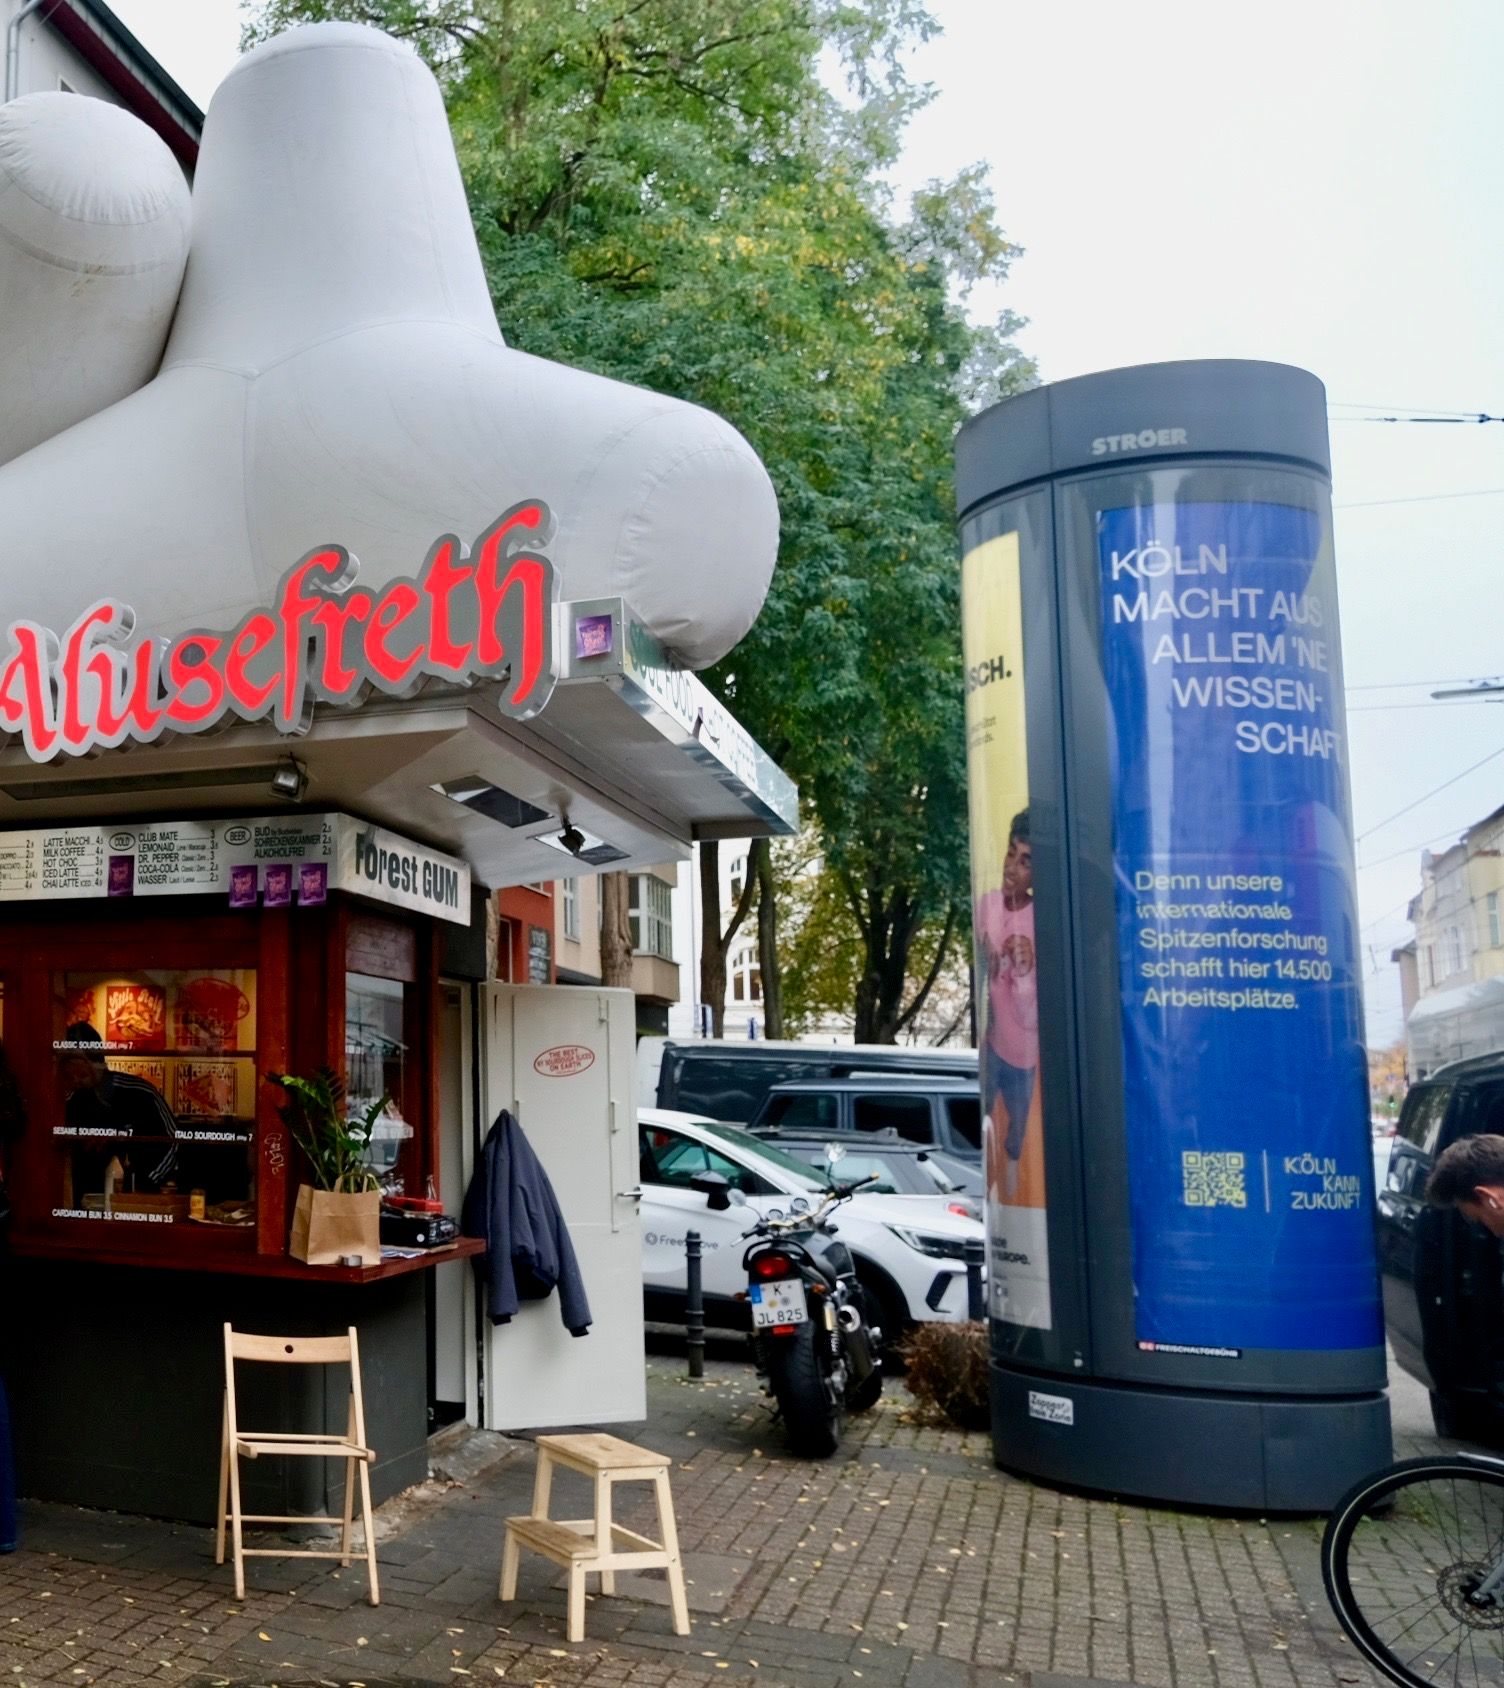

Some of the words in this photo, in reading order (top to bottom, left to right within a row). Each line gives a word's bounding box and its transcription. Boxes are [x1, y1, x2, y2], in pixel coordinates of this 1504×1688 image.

[1091, 428, 1188, 456] STRÖER
[1111, 540, 1228, 581] KÖLN
[1113, 588, 1264, 623] MACHT
[1268, 590, 1323, 628] AUS
[1152, 631, 1286, 665] ALLEM
[1172, 676, 1324, 713] WISSEN-
[43, 837, 63, 847] LATTE
[138, 832, 157, 842] CLUB
[159, 831, 178, 840] MATE
[229, 831, 246, 841] BEER
[43, 848, 58, 857] MILK
[60, 847, 85, 856] COFFEE
[152, 852, 179, 862] PEPPER
[43, 859, 56, 867] HOT
[138, 864, 179, 873] COCA-COLA
[356, 832, 418, 895] Forest
[422, 860, 458, 908] GUM
[59, 868, 79, 877] LATTE
[137, 875, 167, 884] WASSER
[59, 878, 79, 887] LATTE
[1135, 871, 1200, 891] Denn
[1207, 872, 1283, 892] unsere
[1136, 901, 1292, 921] internationale
[1139, 928, 1327, 955] Spitzenforschung
[1141, 958, 1223, 978] schafft
[1229, 958, 1271, 978] hier
[1275, 960, 1332, 982] 14.500
[1143, 986, 1299, 1011] Arbeitsplätze.
[194, 1131, 235, 1141] SOURDOUGH
[1284, 1152, 1336, 1175] KÖLN
[1323, 1175, 1360, 1192] KANN
[1291, 1191, 1360, 1210] ZUKUNFT
[660, 1234, 719, 1249] Freeove
[773, 1284, 782, 1296] K
[758, 1313, 774, 1325] JL
[776, 1309, 802, 1323] 825
